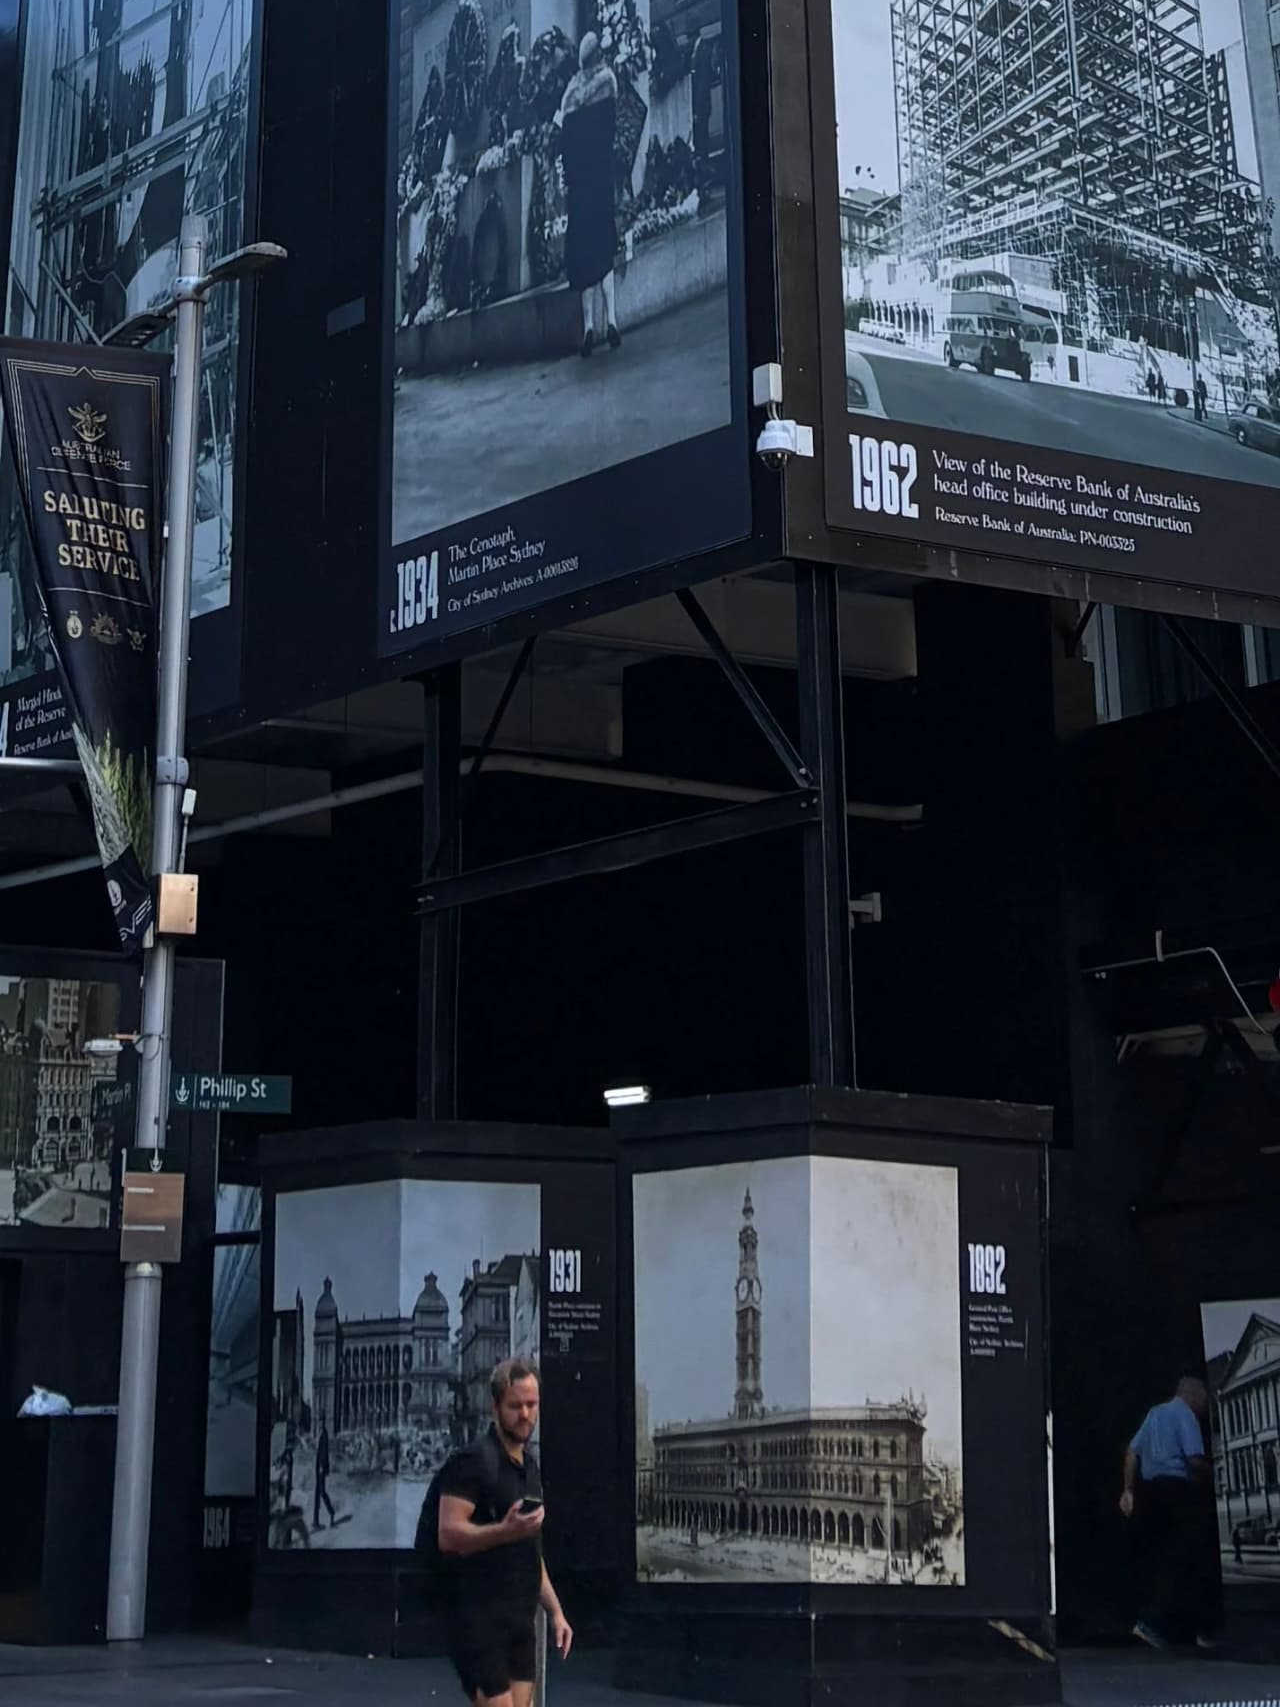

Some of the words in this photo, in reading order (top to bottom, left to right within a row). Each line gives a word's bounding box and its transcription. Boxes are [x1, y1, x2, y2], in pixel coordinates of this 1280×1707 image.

[848, 433, 919, 519] 1962
[932, 450, 967, 472] View
[972, 458, 986, 476] of
[990, 460, 1011, 480] the
[1015, 464, 1072, 491] Reserve
[1076, 475, 1113, 498] Bank
[1116, 483, 1130, 500] of
[1134, 485, 1201, 513] Australia's
[44, 490, 145, 530] SALUTING
[934, 473, 968, 496] head
[972, 481, 1009, 502] office
[1013, 487, 1067, 515] building
[1070, 501, 1109, 519] under
[1113, 509, 1193, 534] construction
[935, 506, 979, 526] Reserve
[982, 514, 1011, 531] Bank
[1014, 521, 1024, 534] of
[66, 519, 129, 553] THEIR
[448, 545, 467, 563] The
[58, 543, 140, 581] SERVICE
[448, 564, 479, 586] Martin
[482, 555, 508, 573] Place
[509, 540, 546, 563] Sydney
[200, 1077, 247, 1103] Phillip
[251, 1077, 267, 1098] St
[548, 1249, 582, 1293] 1931
[967, 1242, 1007, 1295] 1892
[203, 1507, 230, 1547] 1964
